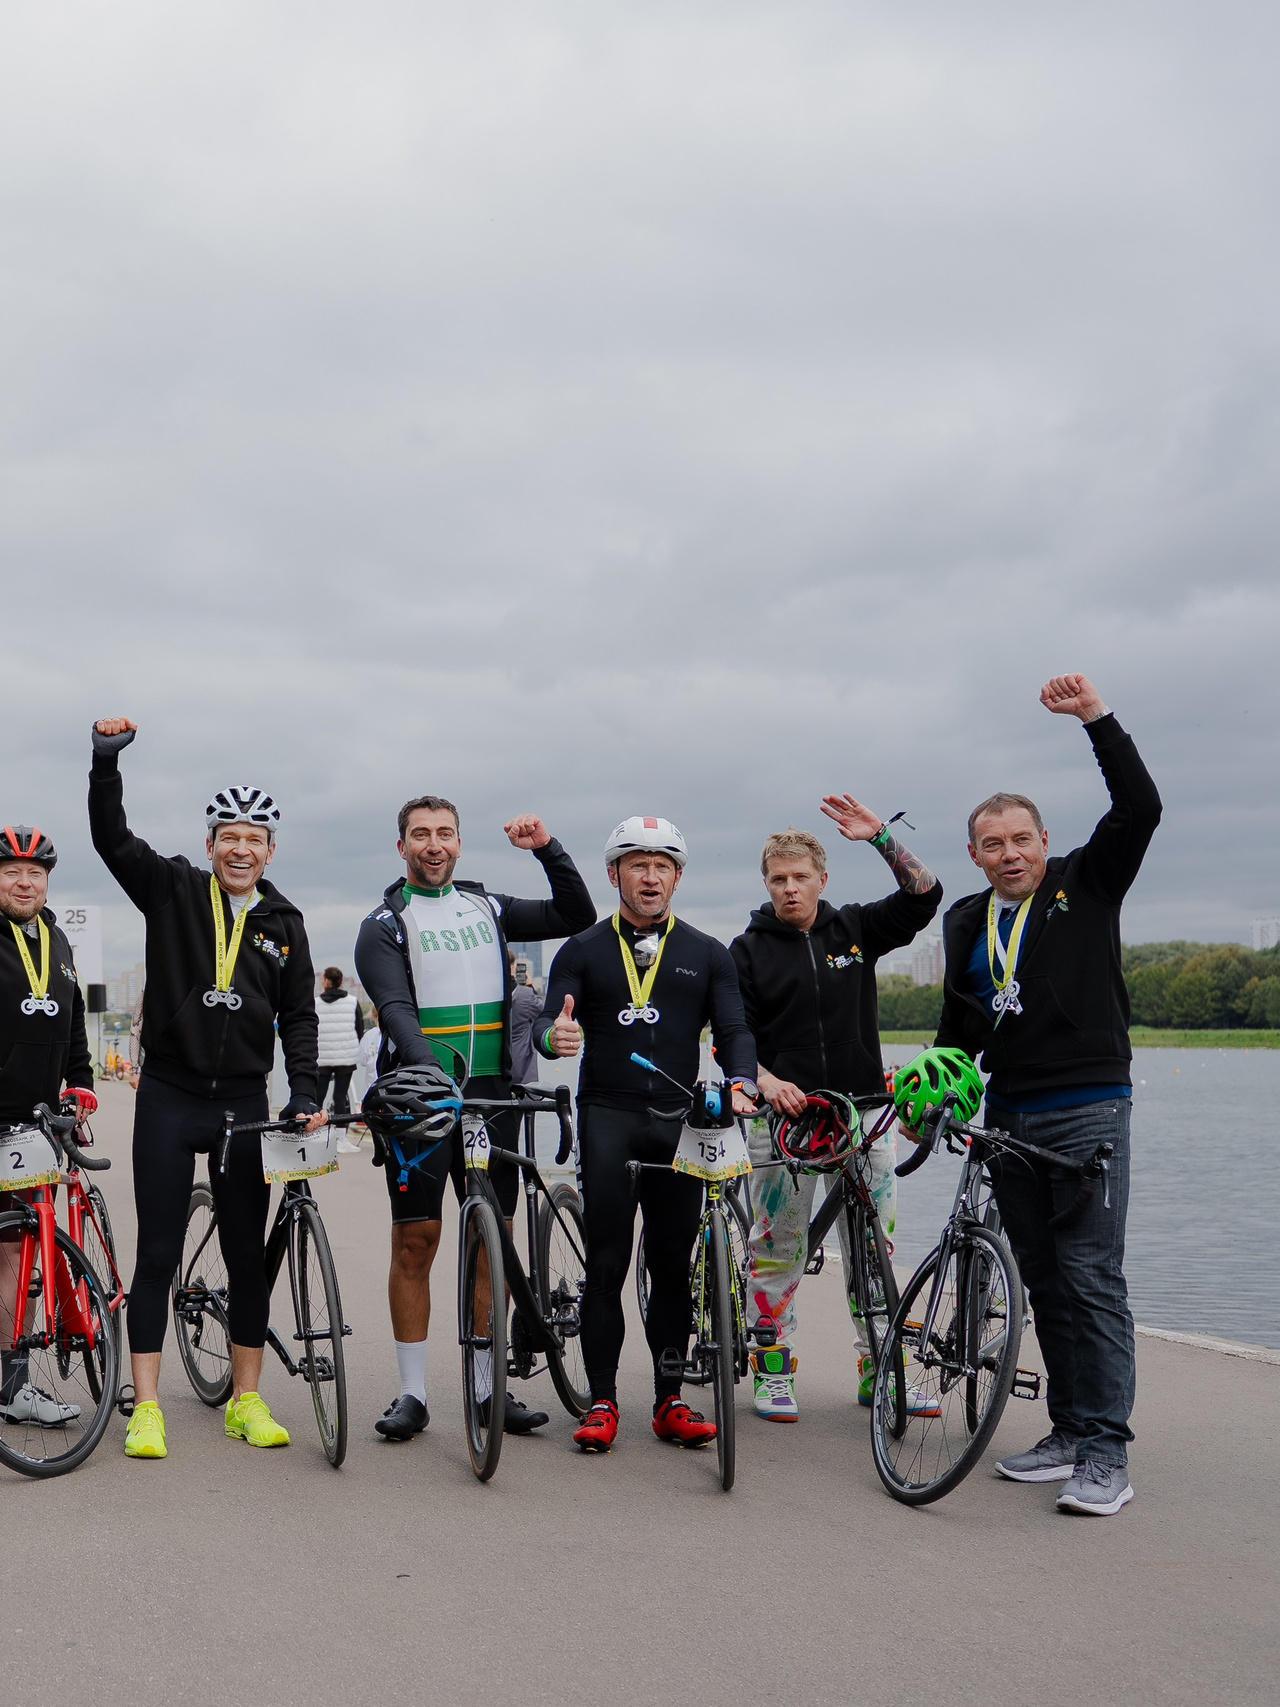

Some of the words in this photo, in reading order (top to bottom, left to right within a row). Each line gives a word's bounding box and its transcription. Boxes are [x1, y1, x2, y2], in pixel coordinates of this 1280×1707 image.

[65, 909, 87, 924] 25
[262, 939, 275, 949] 25
[834, 955, 846, 965] 25
[464, 1130, 487, 1149] 28
[297, 1147, 306, 1162] 1
[698, 1140, 726, 1162] 134
[9, 1152, 25, 1170] 2
